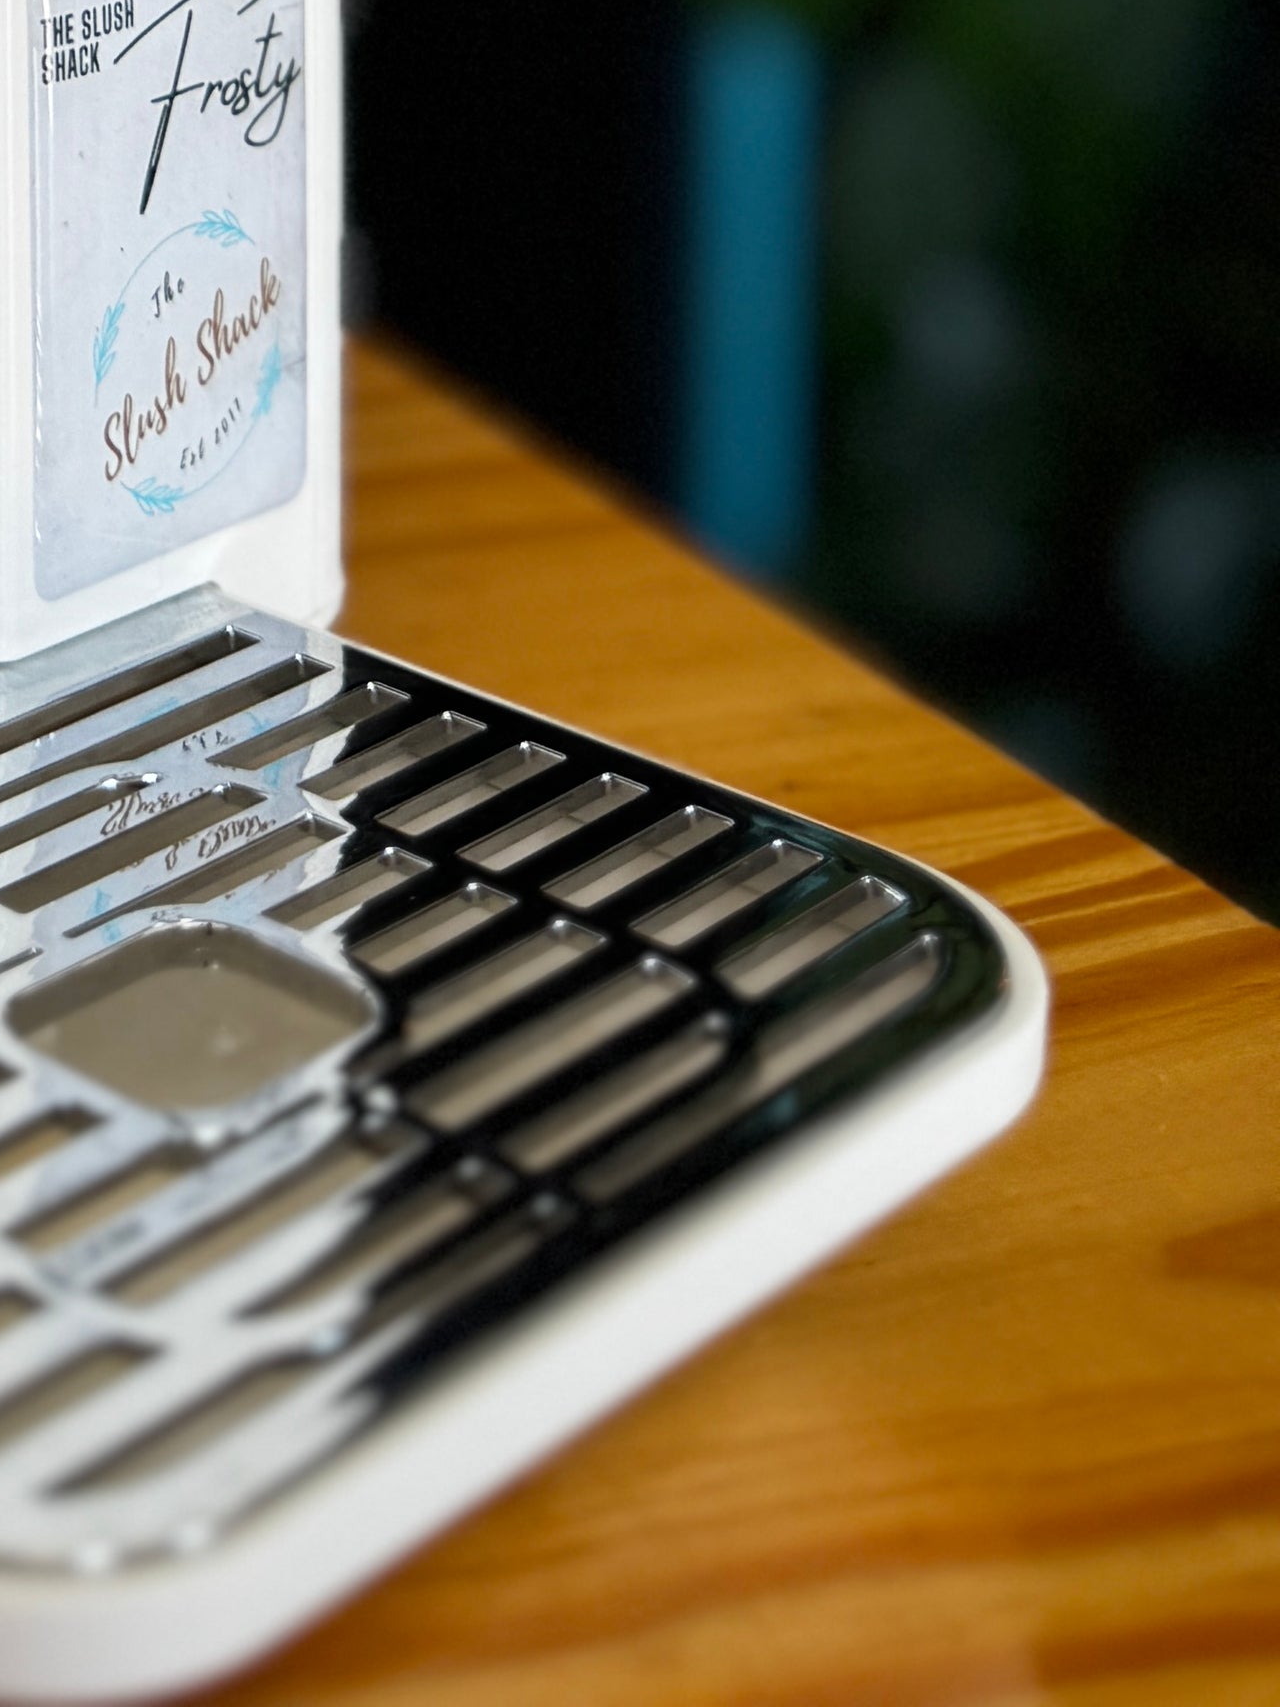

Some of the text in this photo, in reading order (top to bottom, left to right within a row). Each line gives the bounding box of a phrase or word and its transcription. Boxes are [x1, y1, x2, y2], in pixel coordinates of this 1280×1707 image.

[40, 13, 74, 49] THE
[41, 41, 101, 85] SHACK
[103, 256, 281, 482] Slush Shack
